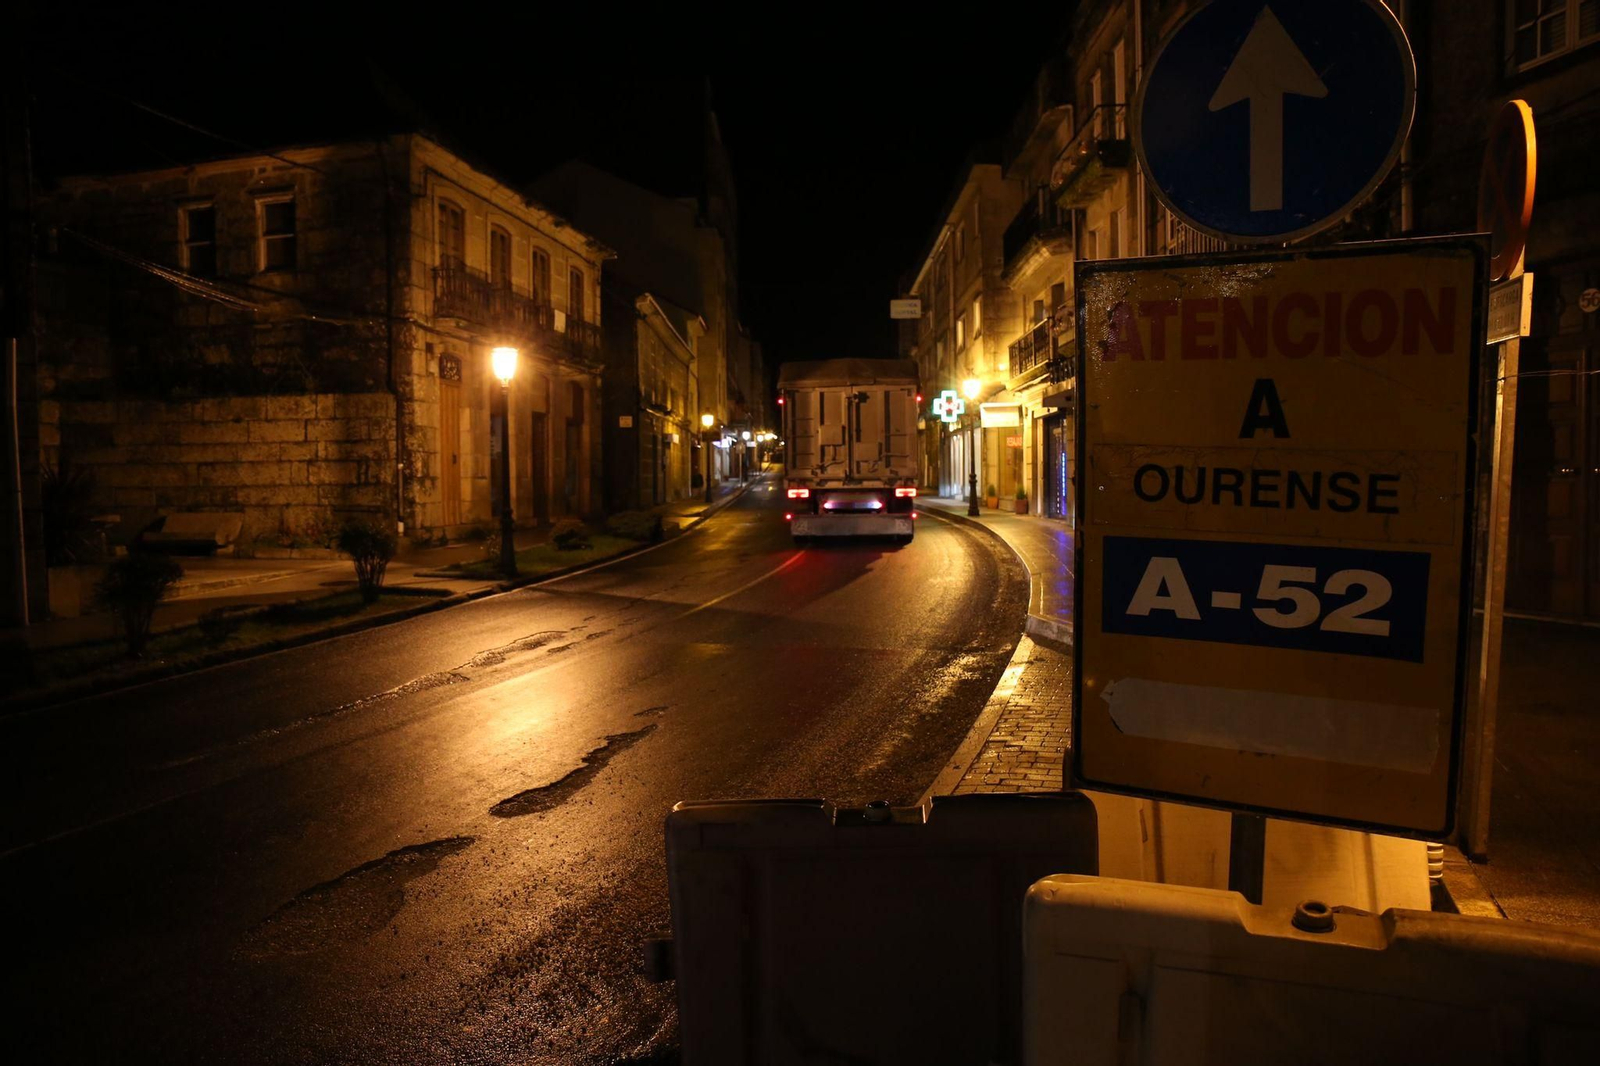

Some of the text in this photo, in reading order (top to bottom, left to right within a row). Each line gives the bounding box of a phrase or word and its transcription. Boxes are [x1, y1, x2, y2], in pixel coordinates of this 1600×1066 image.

[1101, 287, 1457, 362] ATENCION
[1239, 378, 1291, 439] A
[1134, 463, 1400, 515] OURENSE
[1125, 555, 1394, 638] A-52
